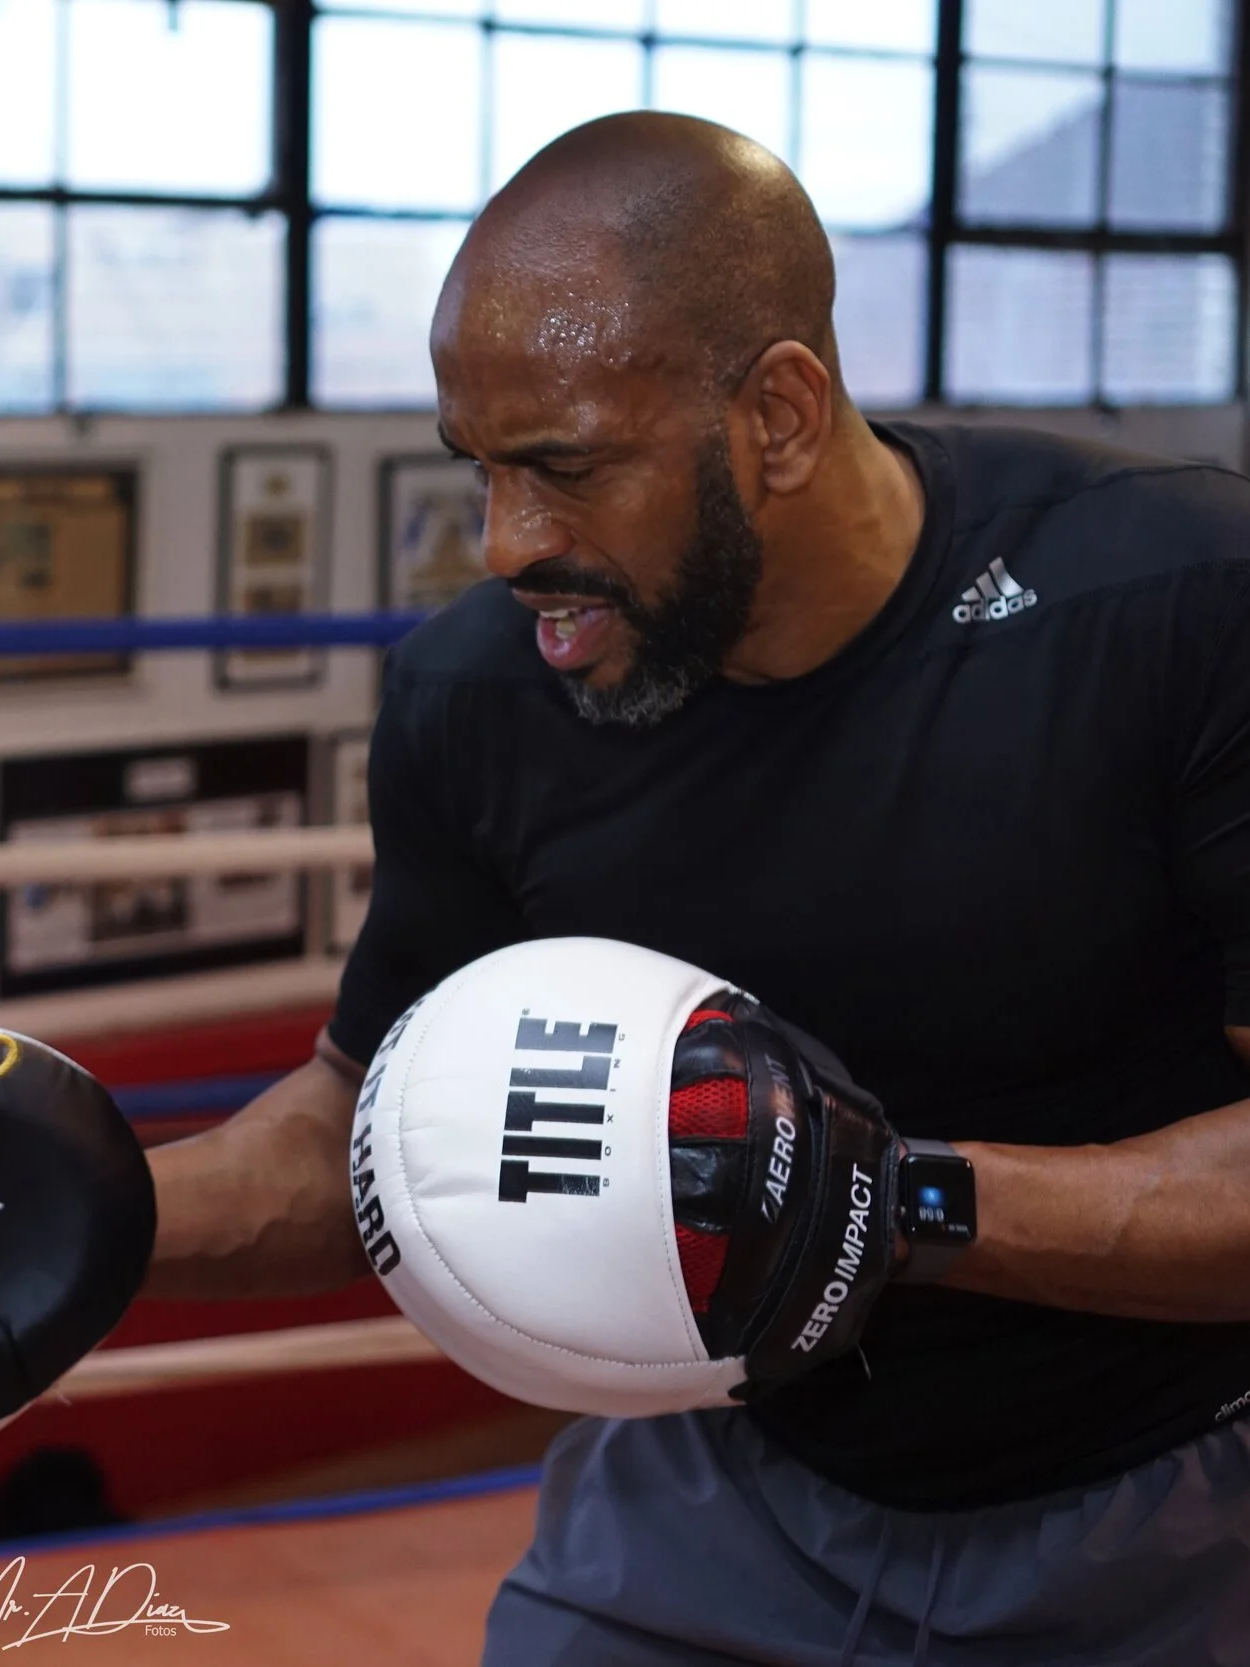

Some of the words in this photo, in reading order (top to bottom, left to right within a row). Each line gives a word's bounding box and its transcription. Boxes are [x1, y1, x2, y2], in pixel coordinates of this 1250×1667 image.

[952, 589, 1038, 624] adidas
[498, 1017, 618, 1204] TITLE
[601, 1033, 626, 1188] BOXING
[352, 1122, 402, 1277] HARD
